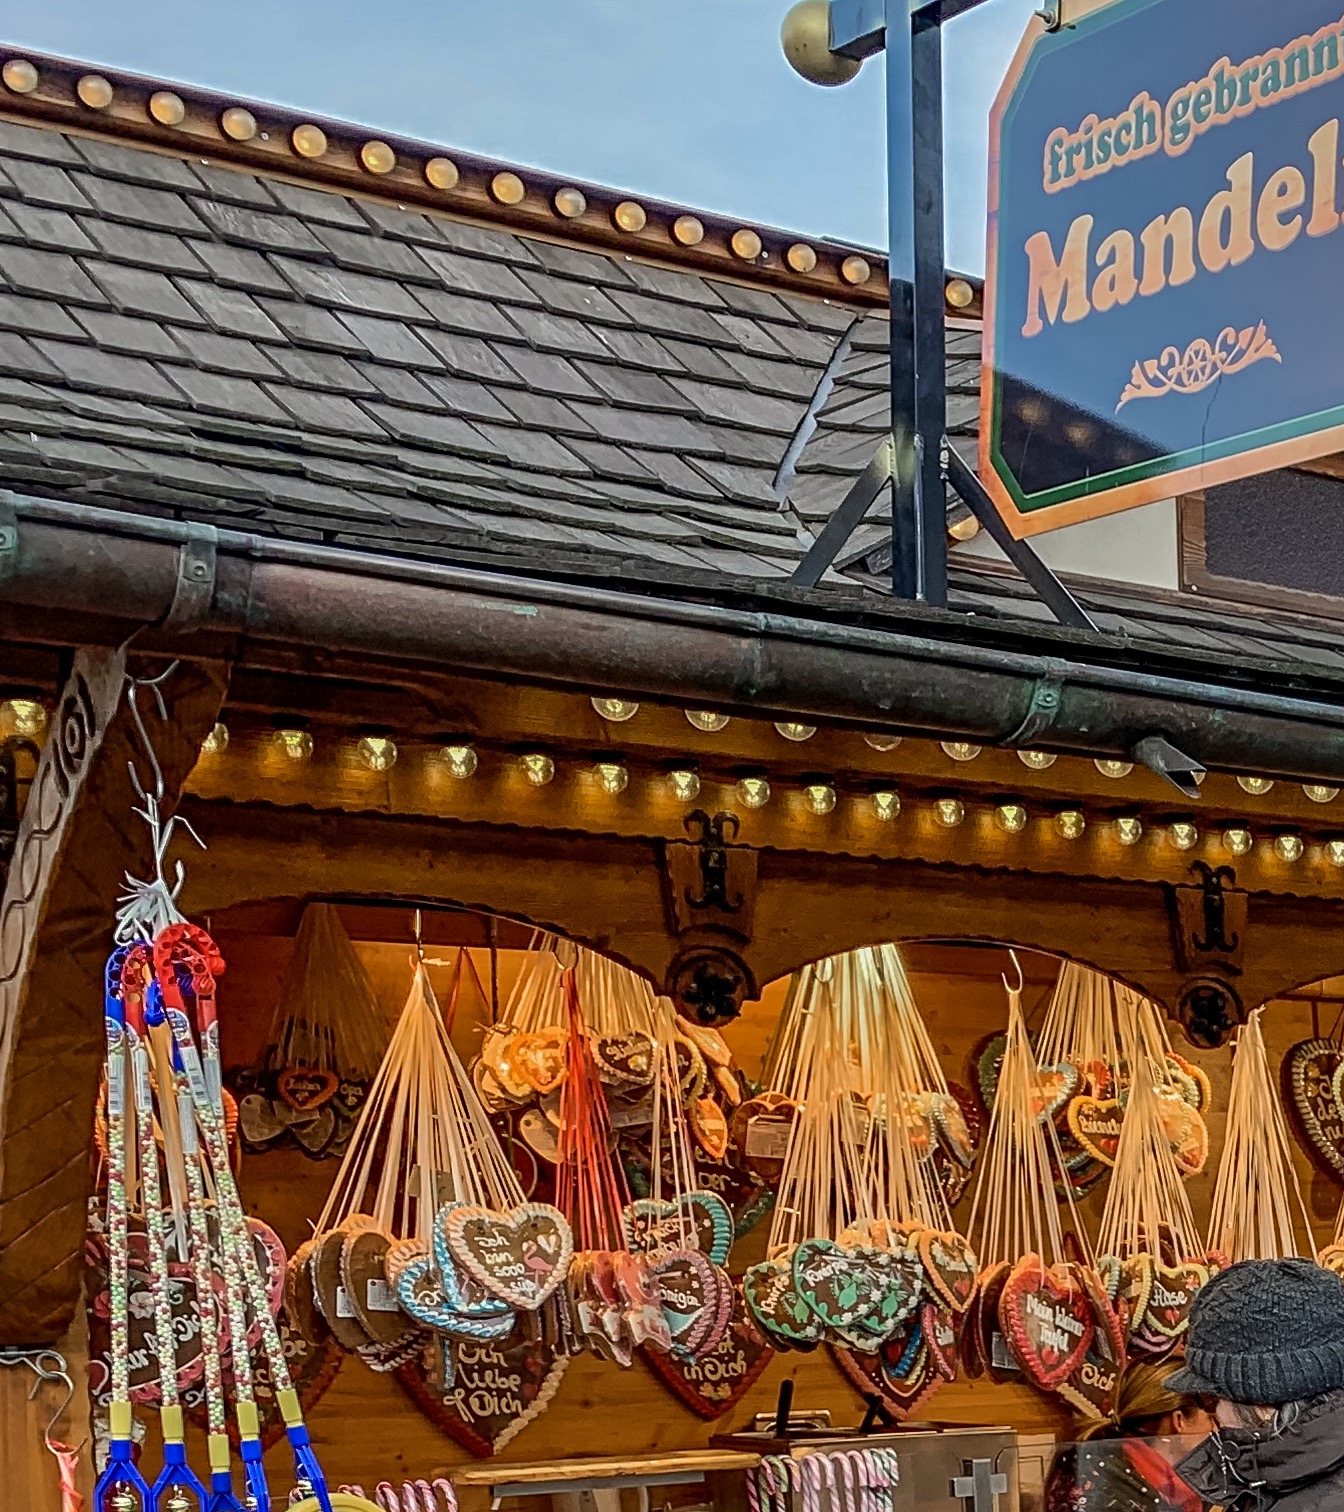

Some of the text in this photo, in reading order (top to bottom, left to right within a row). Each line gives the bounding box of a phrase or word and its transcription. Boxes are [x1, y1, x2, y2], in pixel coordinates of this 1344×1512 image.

[1044, 90, 1162, 194] frisch
[480, 1249, 514, 1264] bin
[660, 1283, 702, 1309] önigin
[1151, 1288, 1189, 1308] Hase
[703, 1351, 748, 1382] Dich
[470, 1390, 524, 1418] Dich
